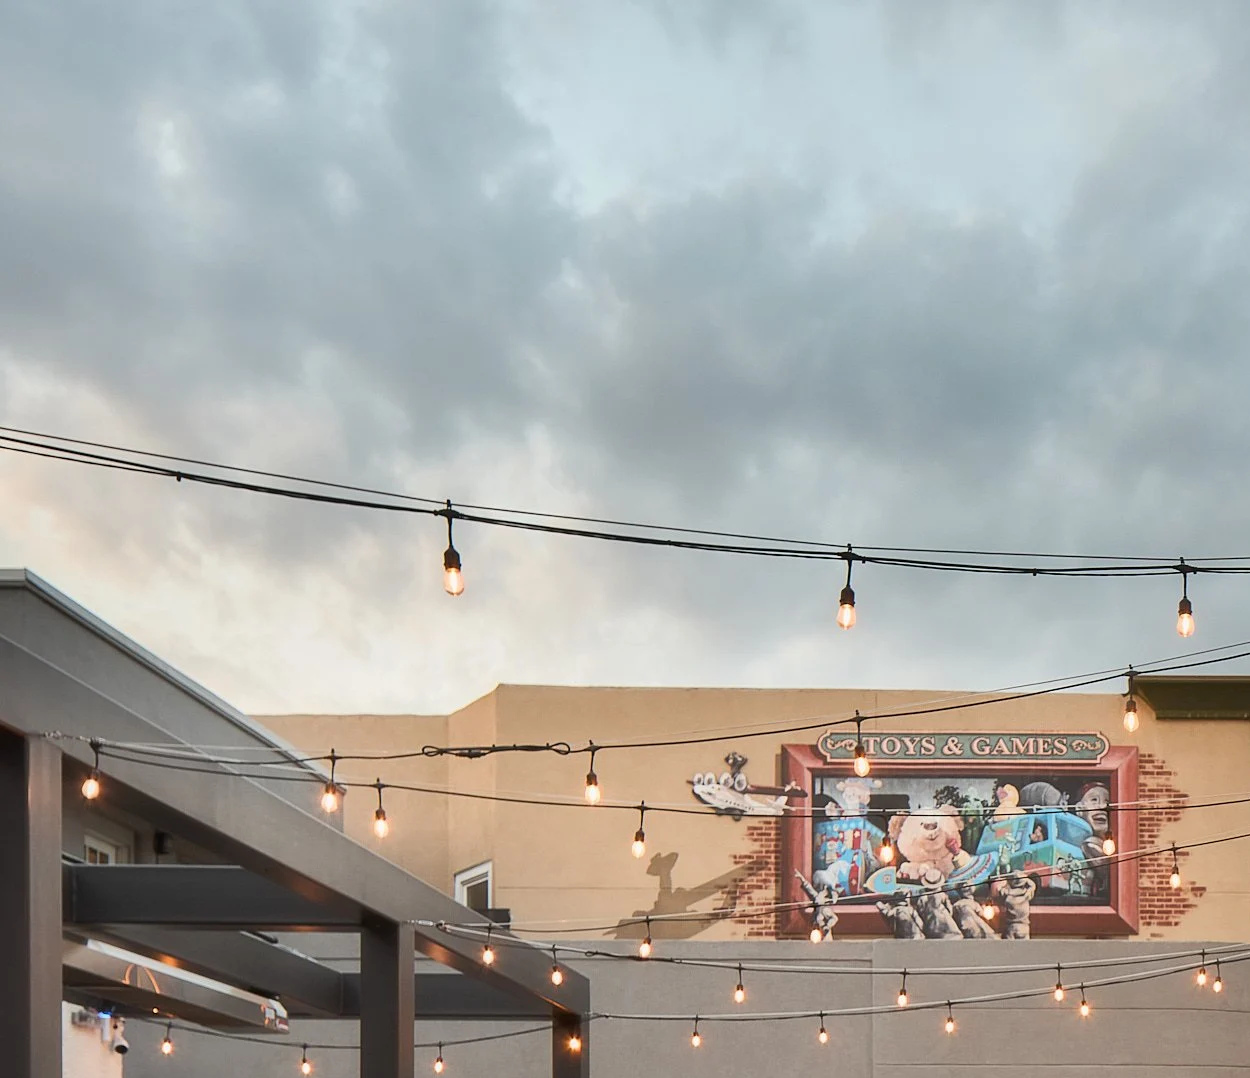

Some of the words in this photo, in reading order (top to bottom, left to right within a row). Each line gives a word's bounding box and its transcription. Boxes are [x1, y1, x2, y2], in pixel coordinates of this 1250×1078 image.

[862, 736, 936, 756] TOYS
[942, 736, 964, 756] &
[971, 736, 1068, 756] GAMES
